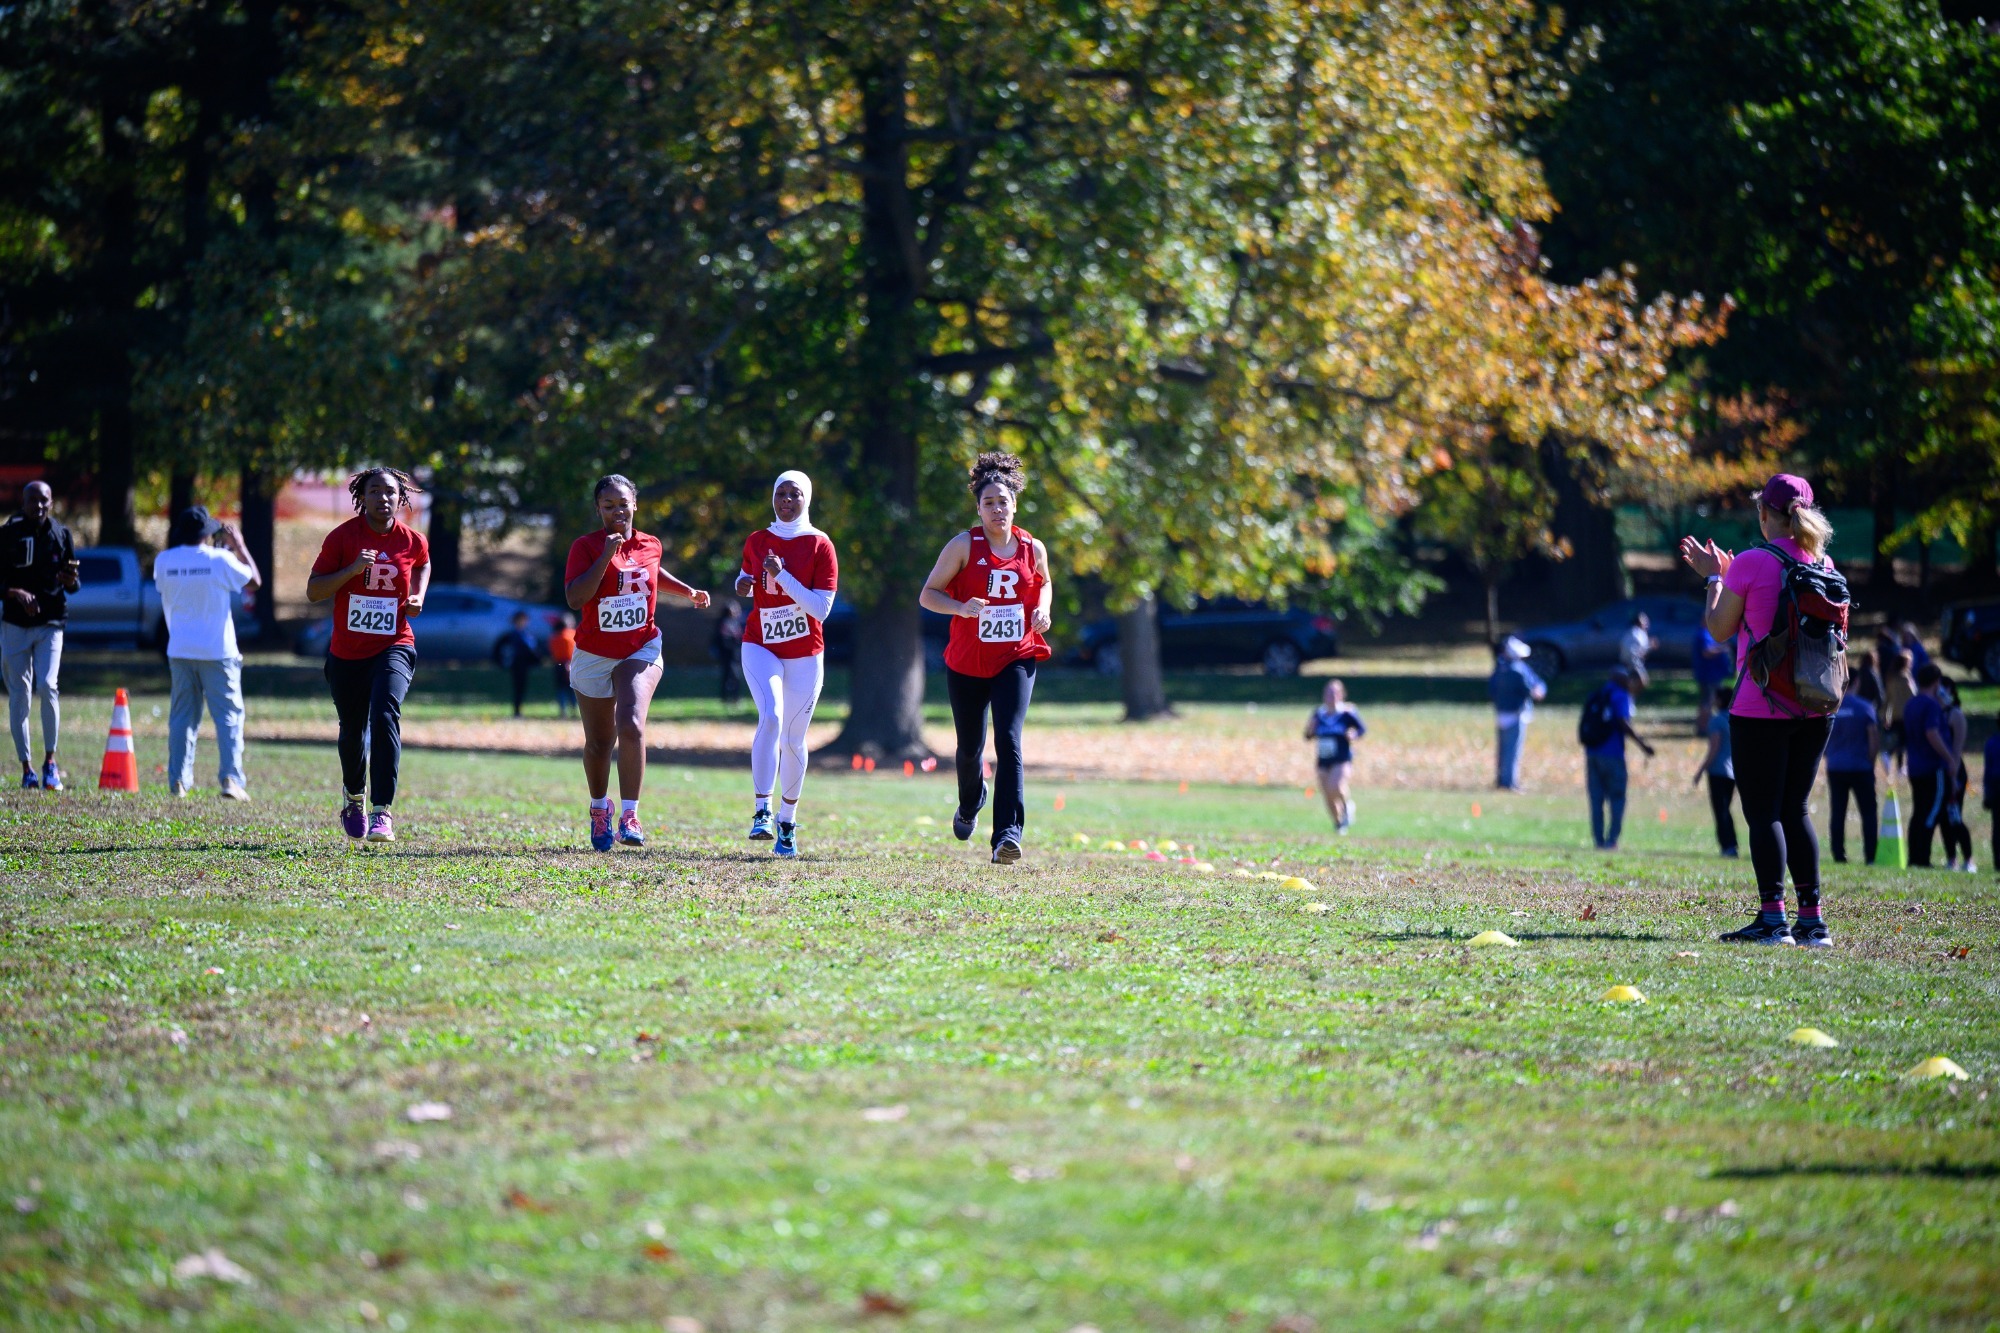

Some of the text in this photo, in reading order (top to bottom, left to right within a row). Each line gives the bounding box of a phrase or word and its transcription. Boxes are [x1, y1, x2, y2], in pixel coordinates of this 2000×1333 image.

[366, 564, 398, 591] R
[619, 567, 651, 595] R
[988, 569, 1019, 599] R
[349, 609, 395, 632] 2429
[600, 607, 646, 628] 2430
[763, 616, 807, 640] 2426
[981, 618, 1023, 639] 2431
